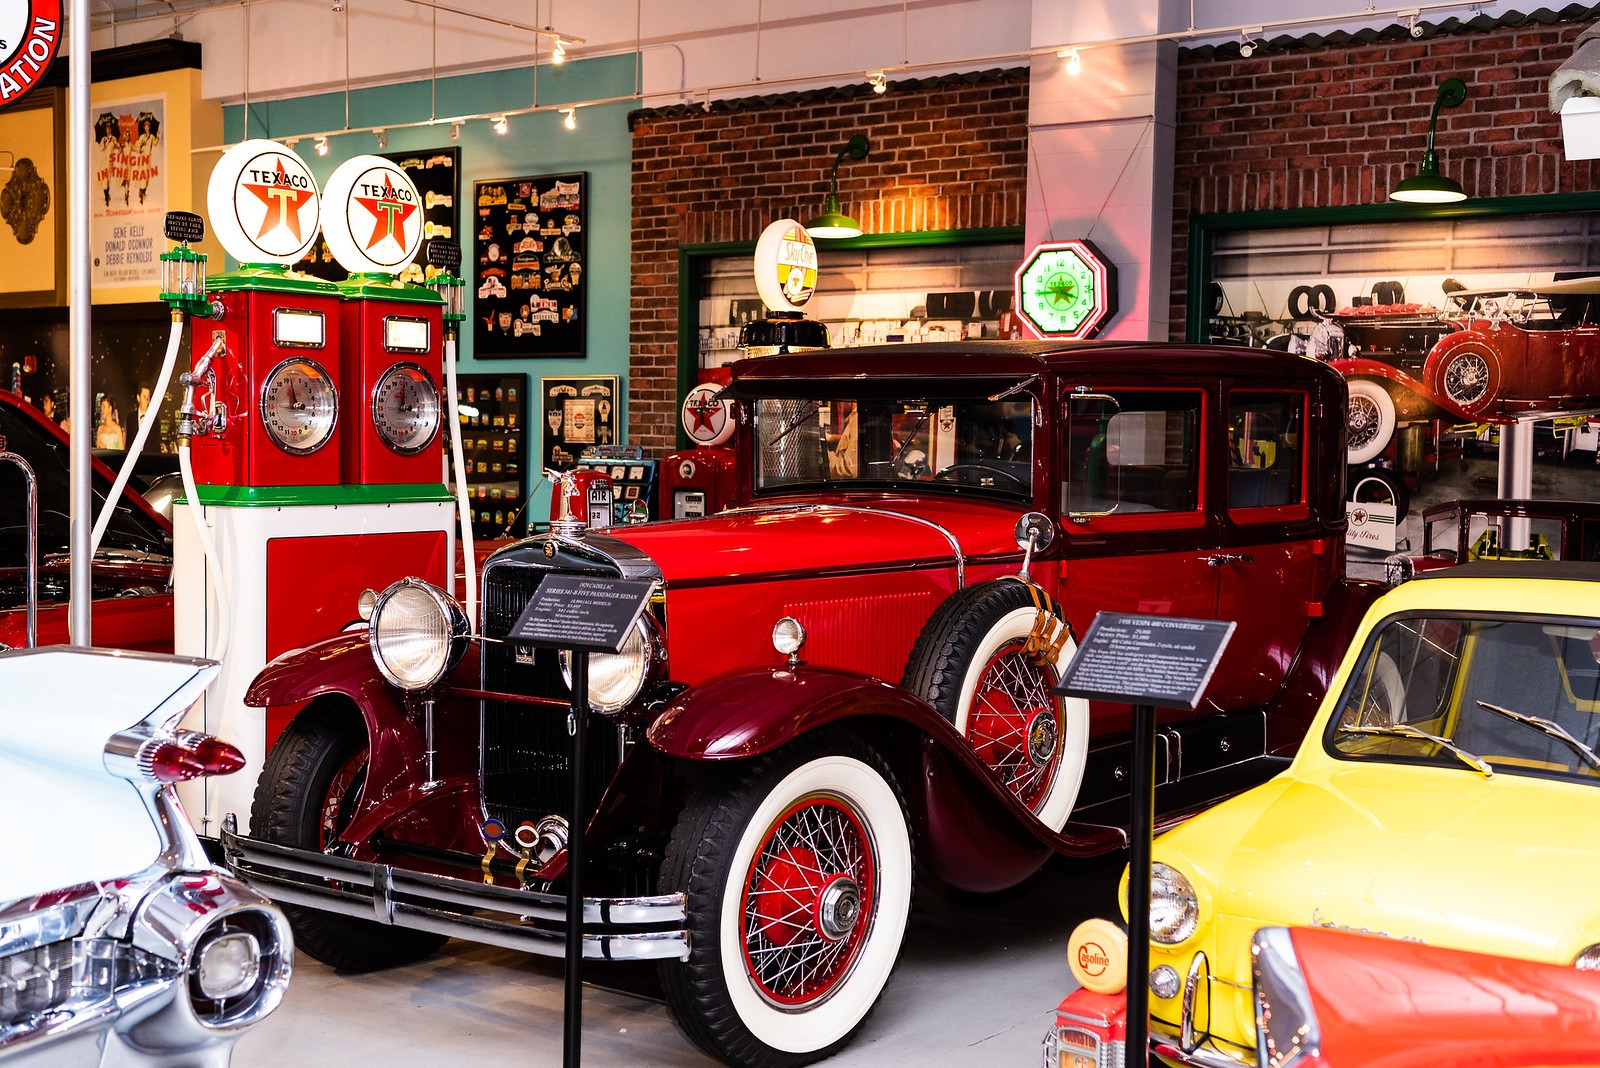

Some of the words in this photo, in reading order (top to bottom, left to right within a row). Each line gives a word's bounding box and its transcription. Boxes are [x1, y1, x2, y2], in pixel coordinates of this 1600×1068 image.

[0, 16, 56, 99] ATION
[109, 152, 152, 167] SINGIN'
[97, 168, 109, 182] IN
[112, 166, 128, 180] THE
[132, 165, 158, 181] RAIN
[250, 169, 308, 189] TEXACO
[360, 184, 412, 202] TEXACO
[268, 188, 298, 225] T
[377, 202, 403, 235] T
[113, 226, 127, 239] GENE
[129, 225, 145, 237] KELLY
[105, 240, 126, 252] DONALD
[128, 238, 153, 251] O'CONNOR
[106, 253, 124, 266] DEBBIE
[126, 250, 152, 264] REYNOLDS
[785, 242, 800, 264] Sky
[1056, 259, 1064, 267] 12
[1073, 311, 1079, 319] 5
[592, 491, 606, 501] AIR
[1346, 528, 1358, 540] lity
[1360, 530, 1380, 540] Tires
[590, 590, 620, 598] PASSENGER
[1161, 622, 1205, 631] CONVERTIBLE
[1078, 945, 1110, 969] Gasoline
